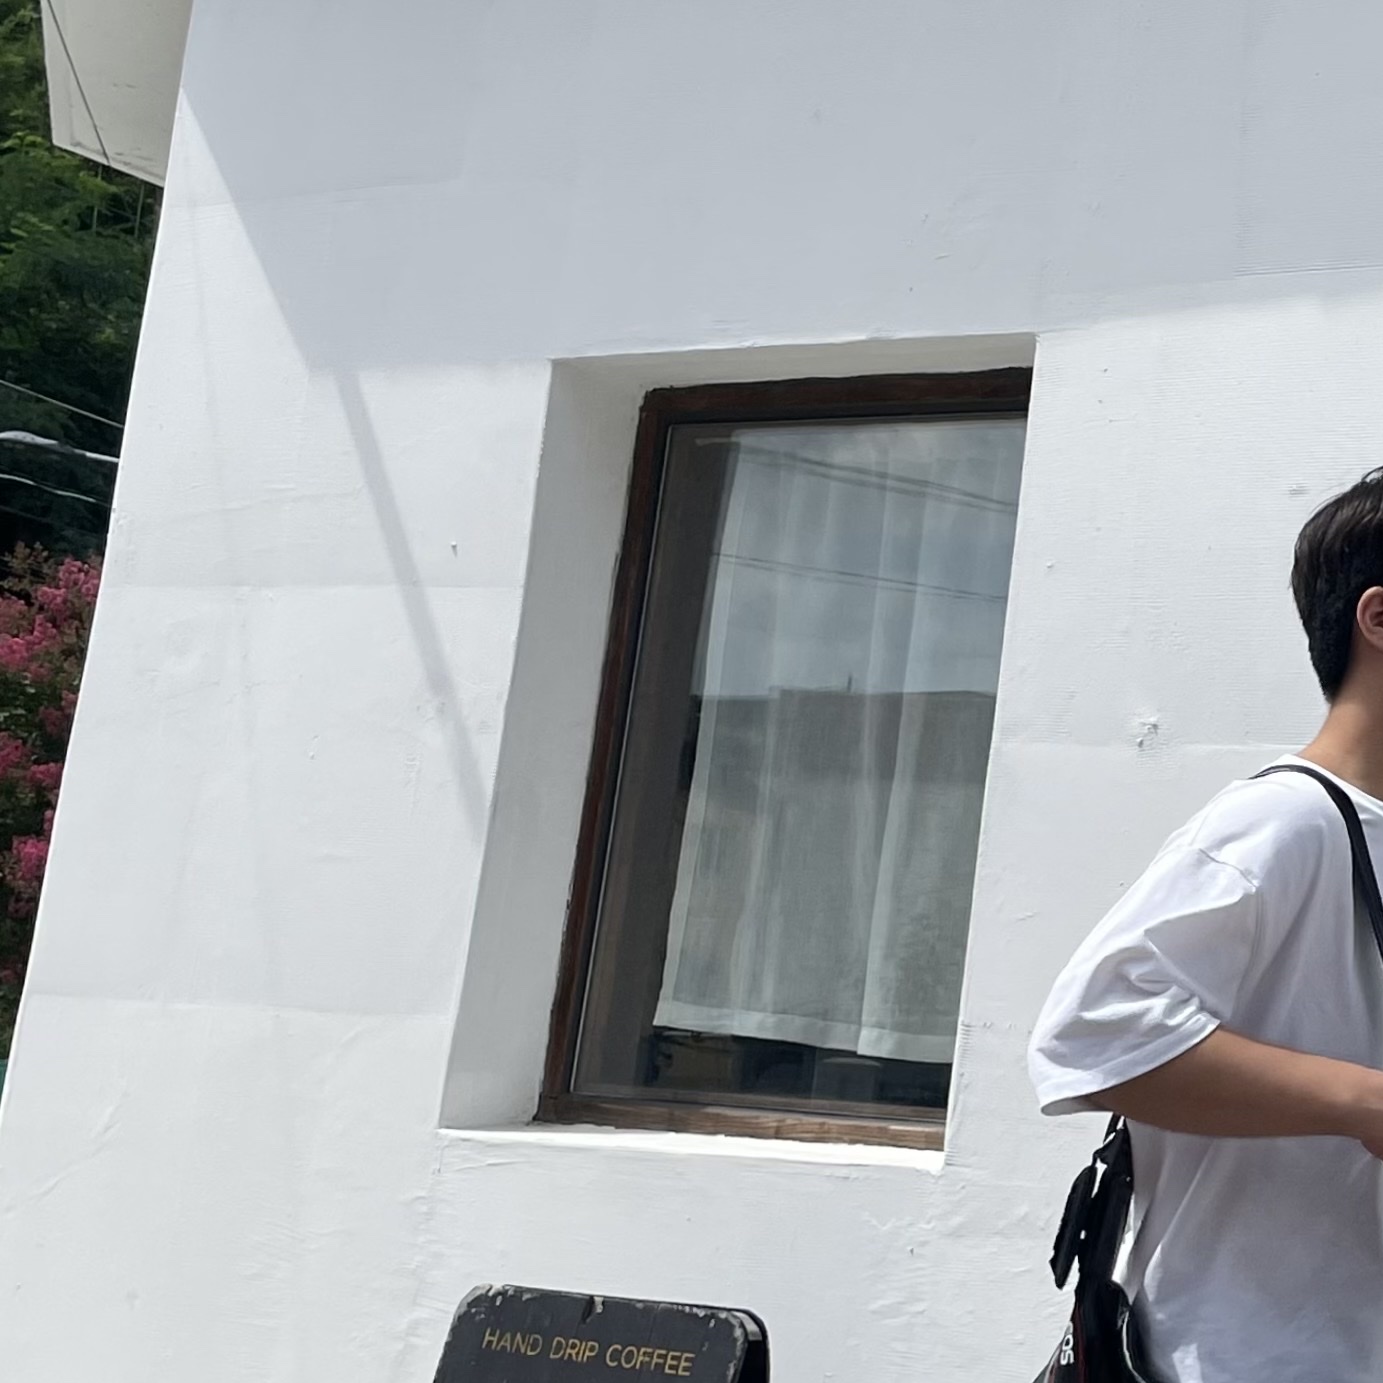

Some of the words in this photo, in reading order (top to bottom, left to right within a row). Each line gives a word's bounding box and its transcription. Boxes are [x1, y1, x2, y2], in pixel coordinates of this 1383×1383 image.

[482, 1327, 543, 1356] HAND
[550, 1336, 600, 1363] DRIP
[605, 1343, 696, 1377] COFFEE
